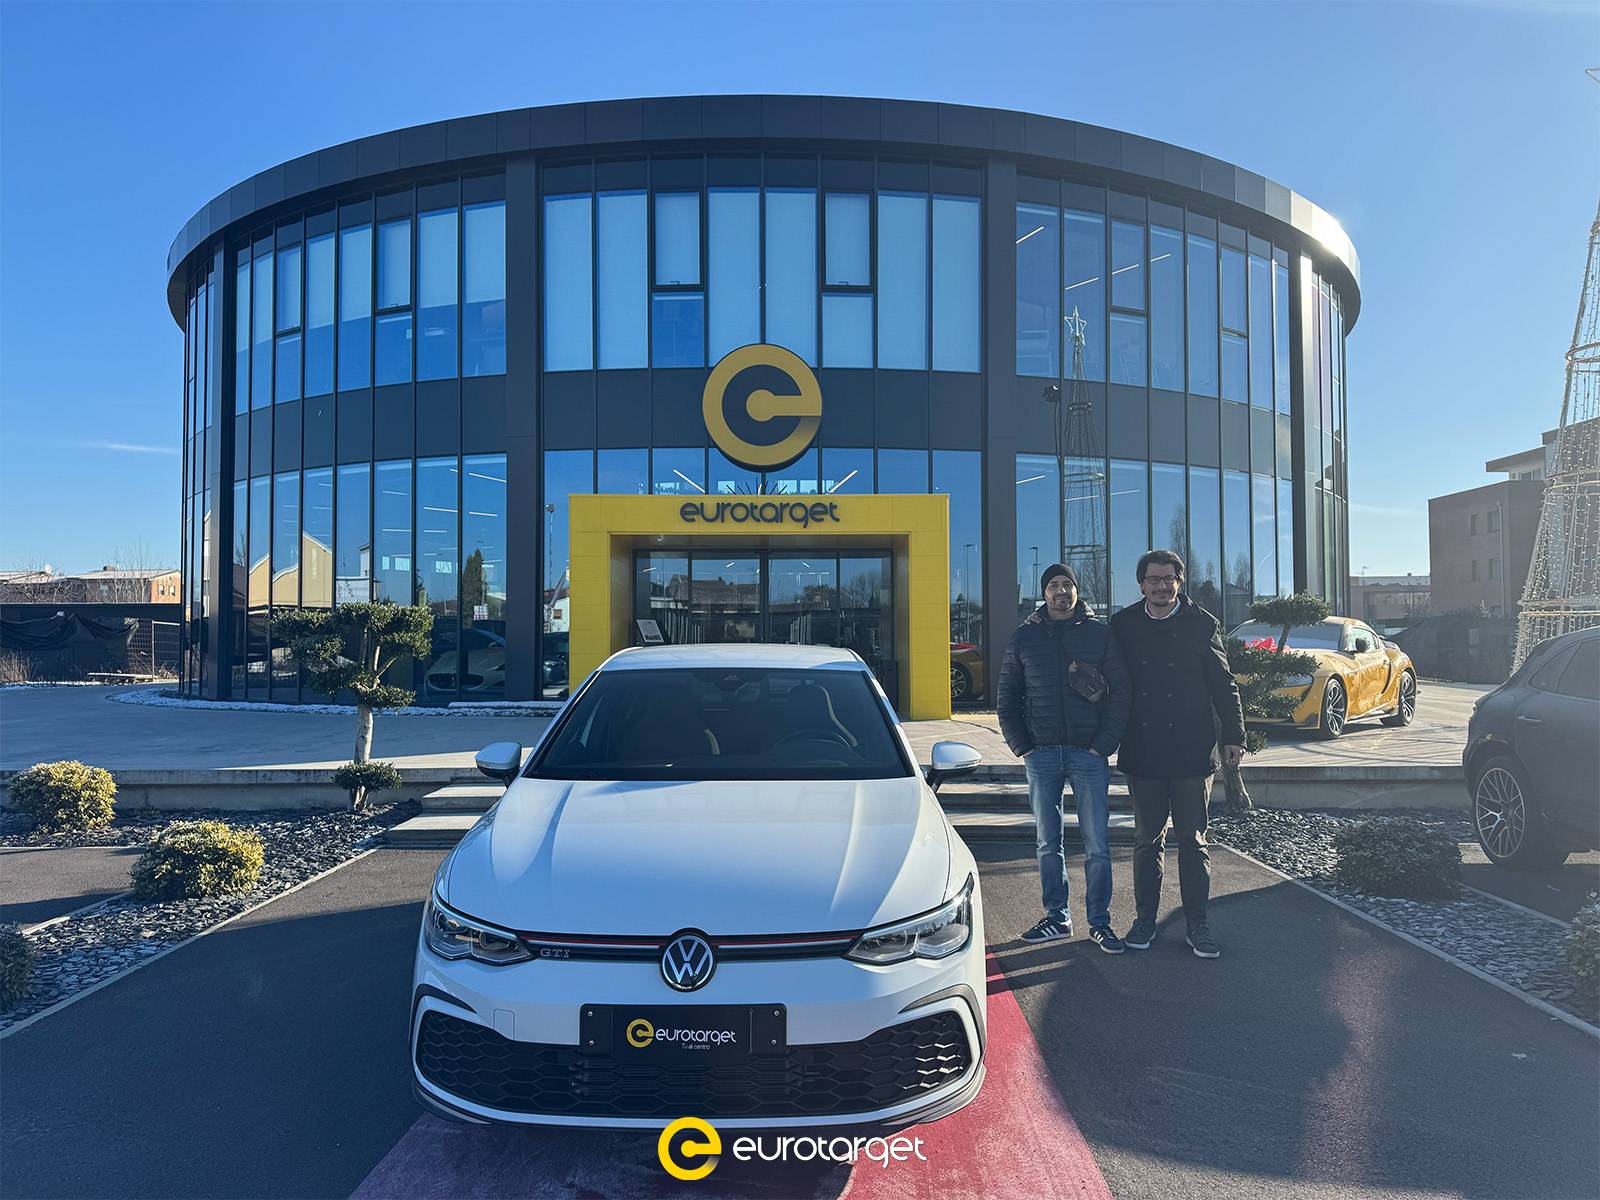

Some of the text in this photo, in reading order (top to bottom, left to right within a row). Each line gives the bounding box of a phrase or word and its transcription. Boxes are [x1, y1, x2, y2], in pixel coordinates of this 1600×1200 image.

[680, 502, 840, 528] eurotarget
[540, 948, 570, 958] GTI
[655, 1028, 736, 1046] eurotarget
